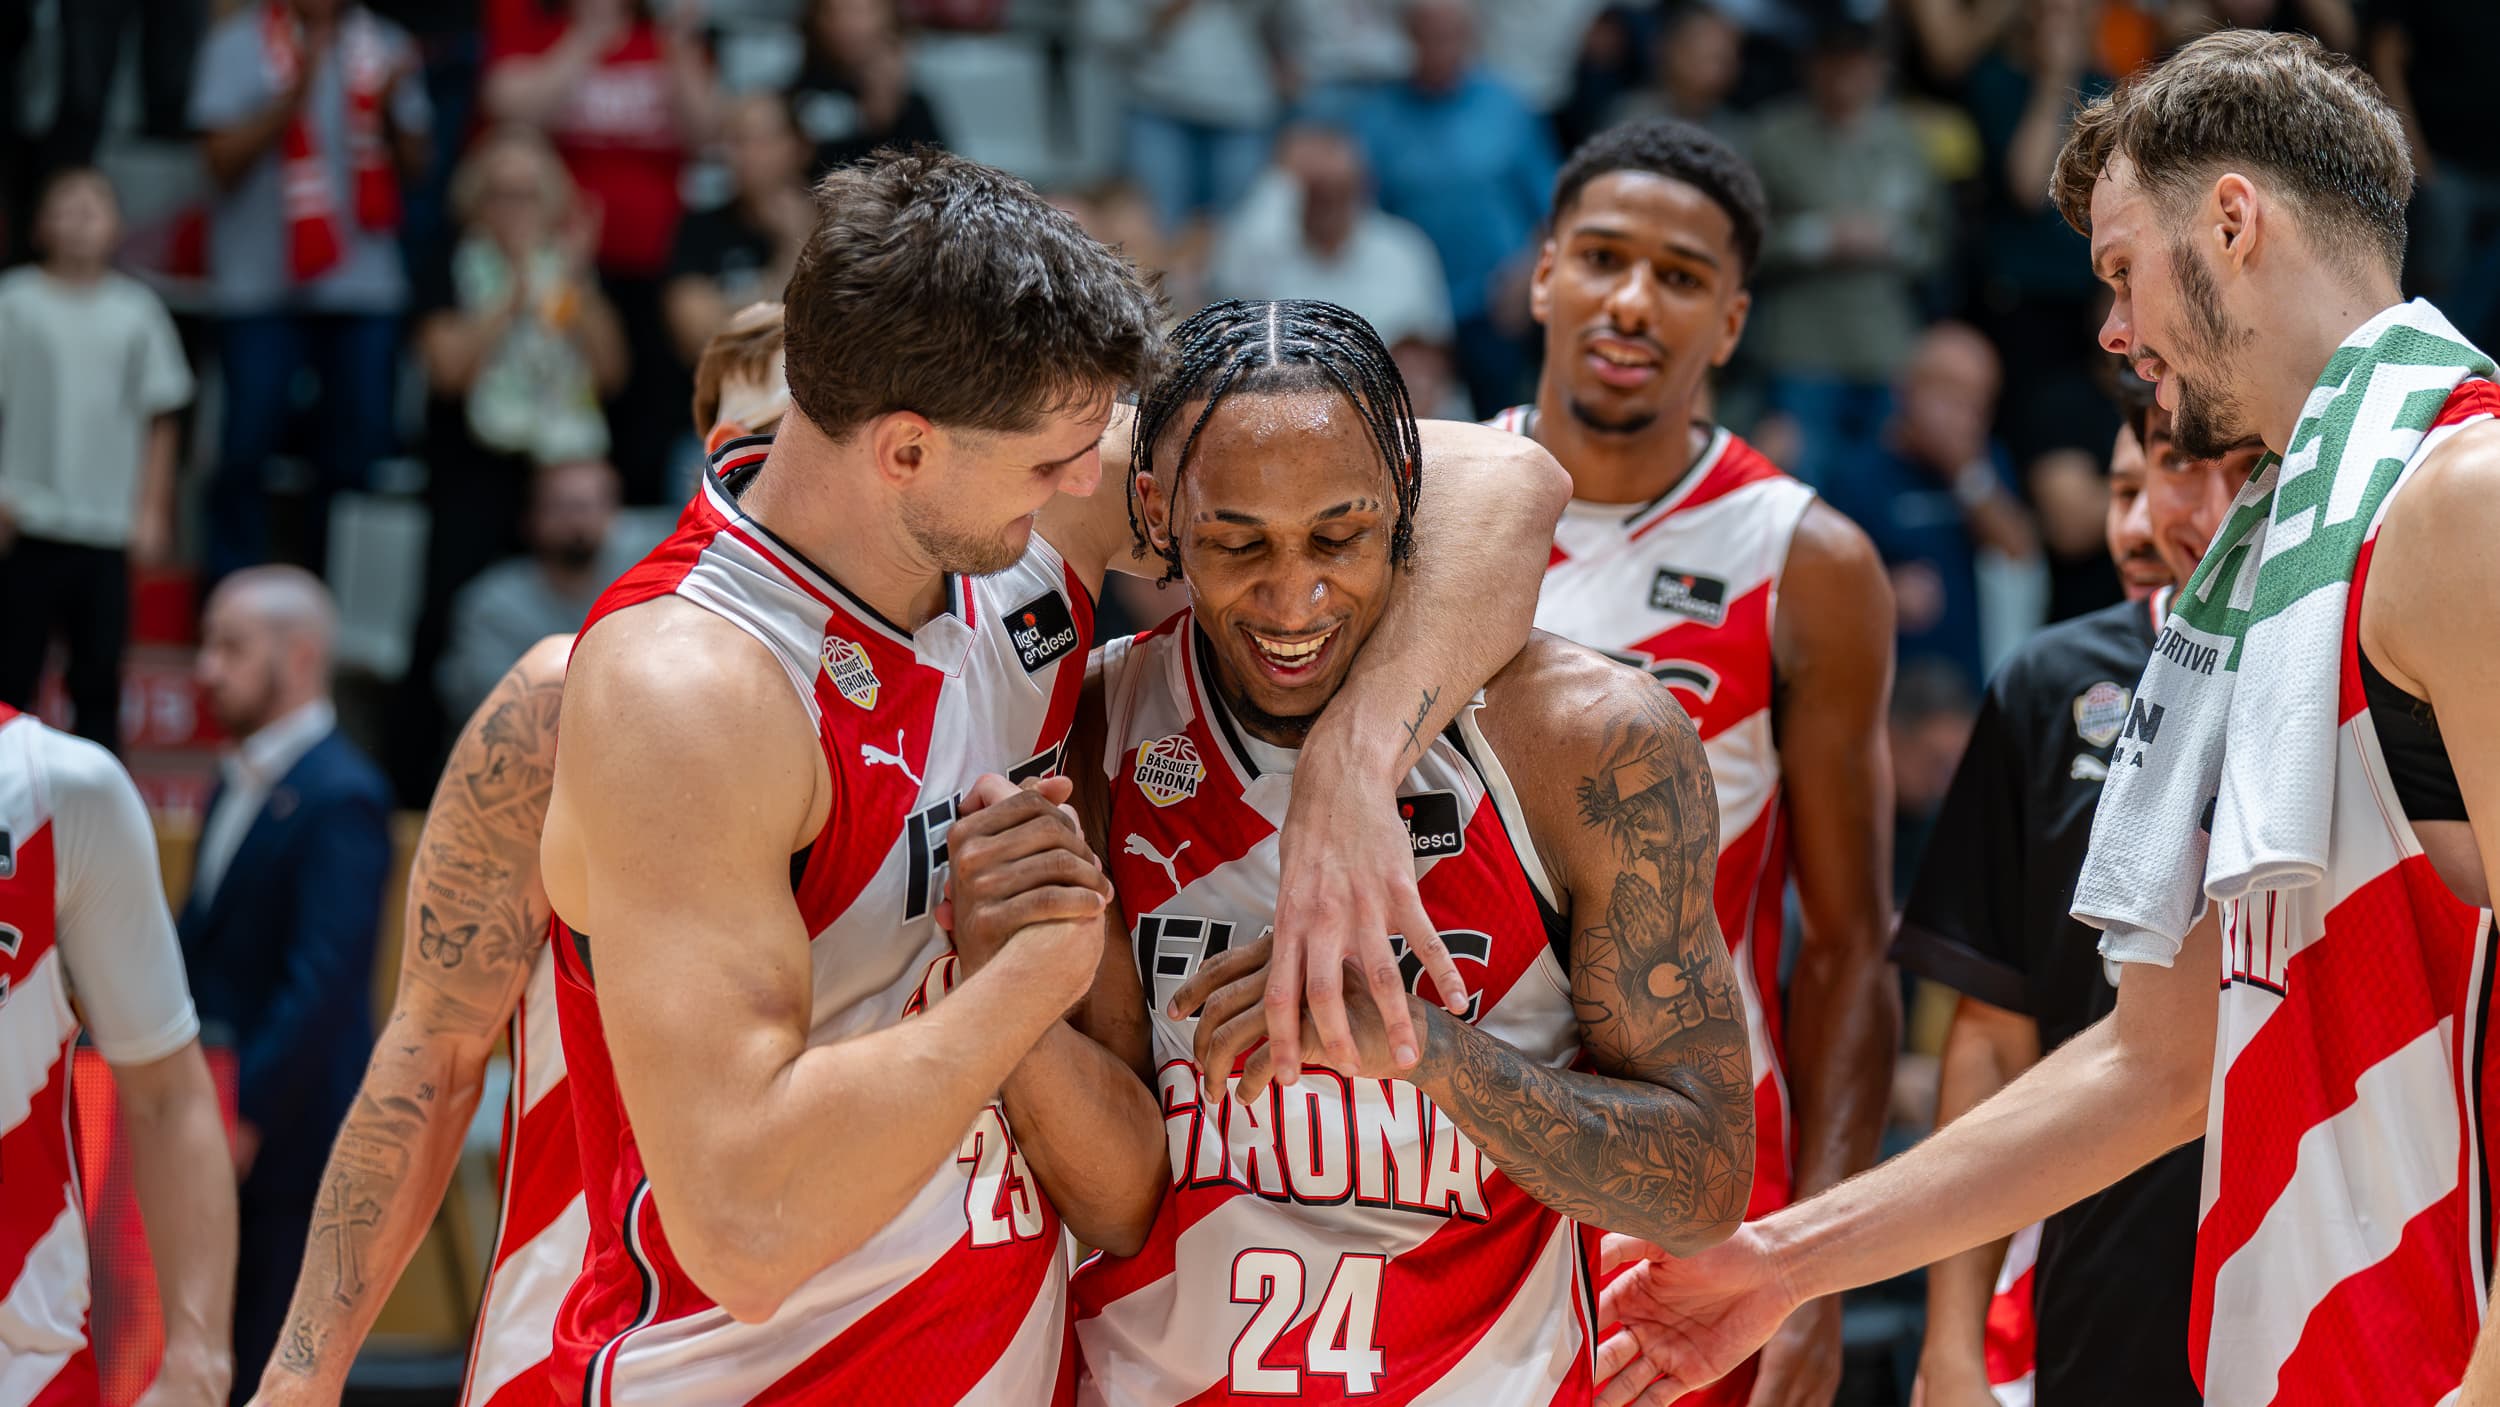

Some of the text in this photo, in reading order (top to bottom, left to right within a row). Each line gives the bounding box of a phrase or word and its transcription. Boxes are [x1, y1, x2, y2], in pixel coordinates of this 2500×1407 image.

[1014, 626, 1041, 650] liga
[1024, 627, 1074, 665] endesa
[837, 669, 879, 696] GIRONA
[1136, 765, 1196, 795] GIRONA
[1157, 1057, 1493, 1226] GIRONA
[1228, 1247, 1388, 1398] 24
